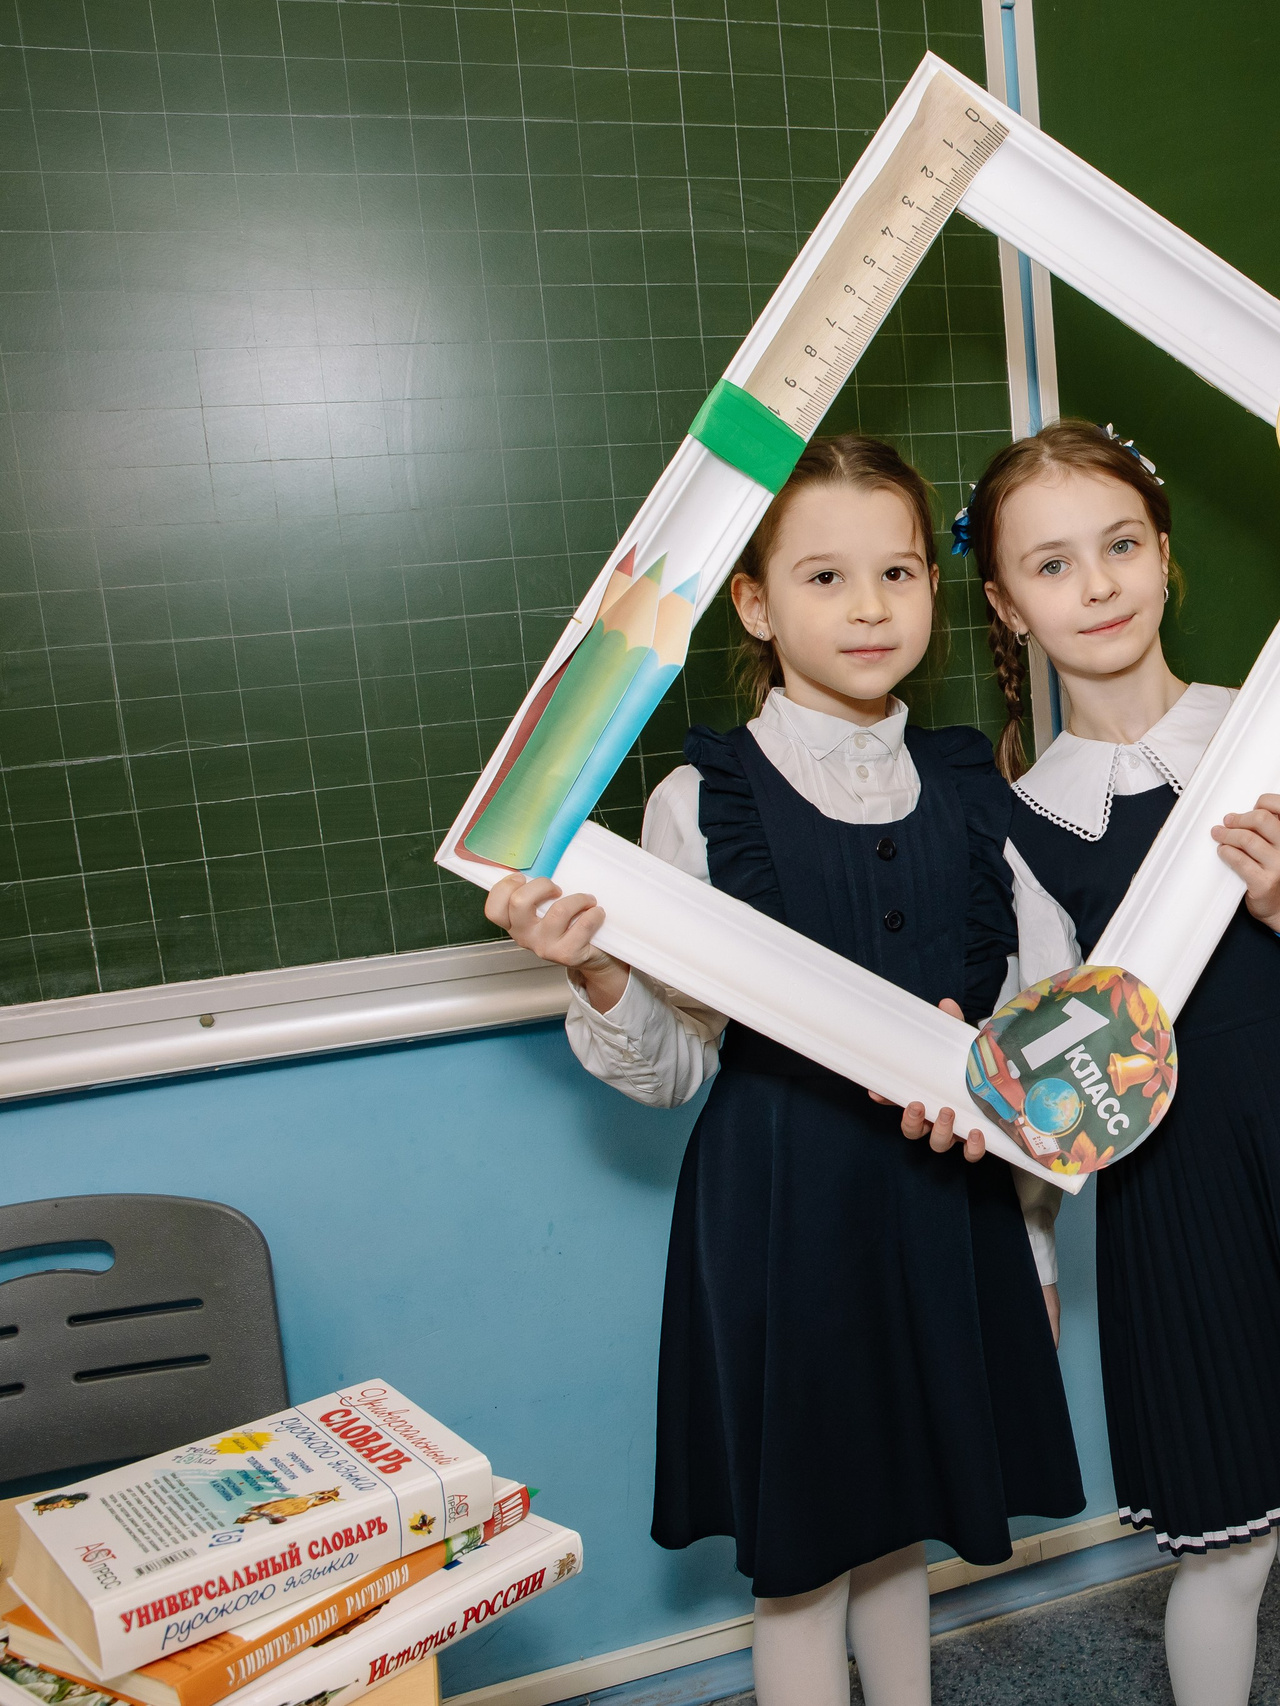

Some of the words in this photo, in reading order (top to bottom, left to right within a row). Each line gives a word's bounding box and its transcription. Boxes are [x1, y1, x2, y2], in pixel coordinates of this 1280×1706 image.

[964, 107, 981, 123] 0
[942, 138, 955, 150] 1
[920, 165, 934, 179] 2
[901, 195, 915, 208] 3
[880, 226, 894, 239] 4
[863, 254, 876, 268] 5
[843, 283, 856, 296] 6
[825, 317, 837, 329] 7
[804, 344, 818, 358] 8
[784, 376, 797, 388] 9
[1020, 997, 1110, 1071] 1
[1063, 1043, 1130, 1136] КЛАСС
[340, 1388, 460, 1466] Универсальный
[319, 1408, 413, 1475] СЛОВАРЬ
[268, 1416, 341, 1459] русского
[327, 1459, 378, 1492] языка
[120, 1542, 302, 1633] УНИВЕРСАЛЬНЫЙ
[308, 1516, 388, 1560] СЛОВАРЬ
[161, 1583, 277, 1650] русского
[283, 1552, 360, 1593] языка
[226, 1604, 339, 1687] УДИВИТЕЛЬНЫЕ
[345, 1563, 410, 1616] РАСТЕНИЯ
[366, 1620, 458, 1686] История
[459, 1567, 547, 1634] РОССИИ
